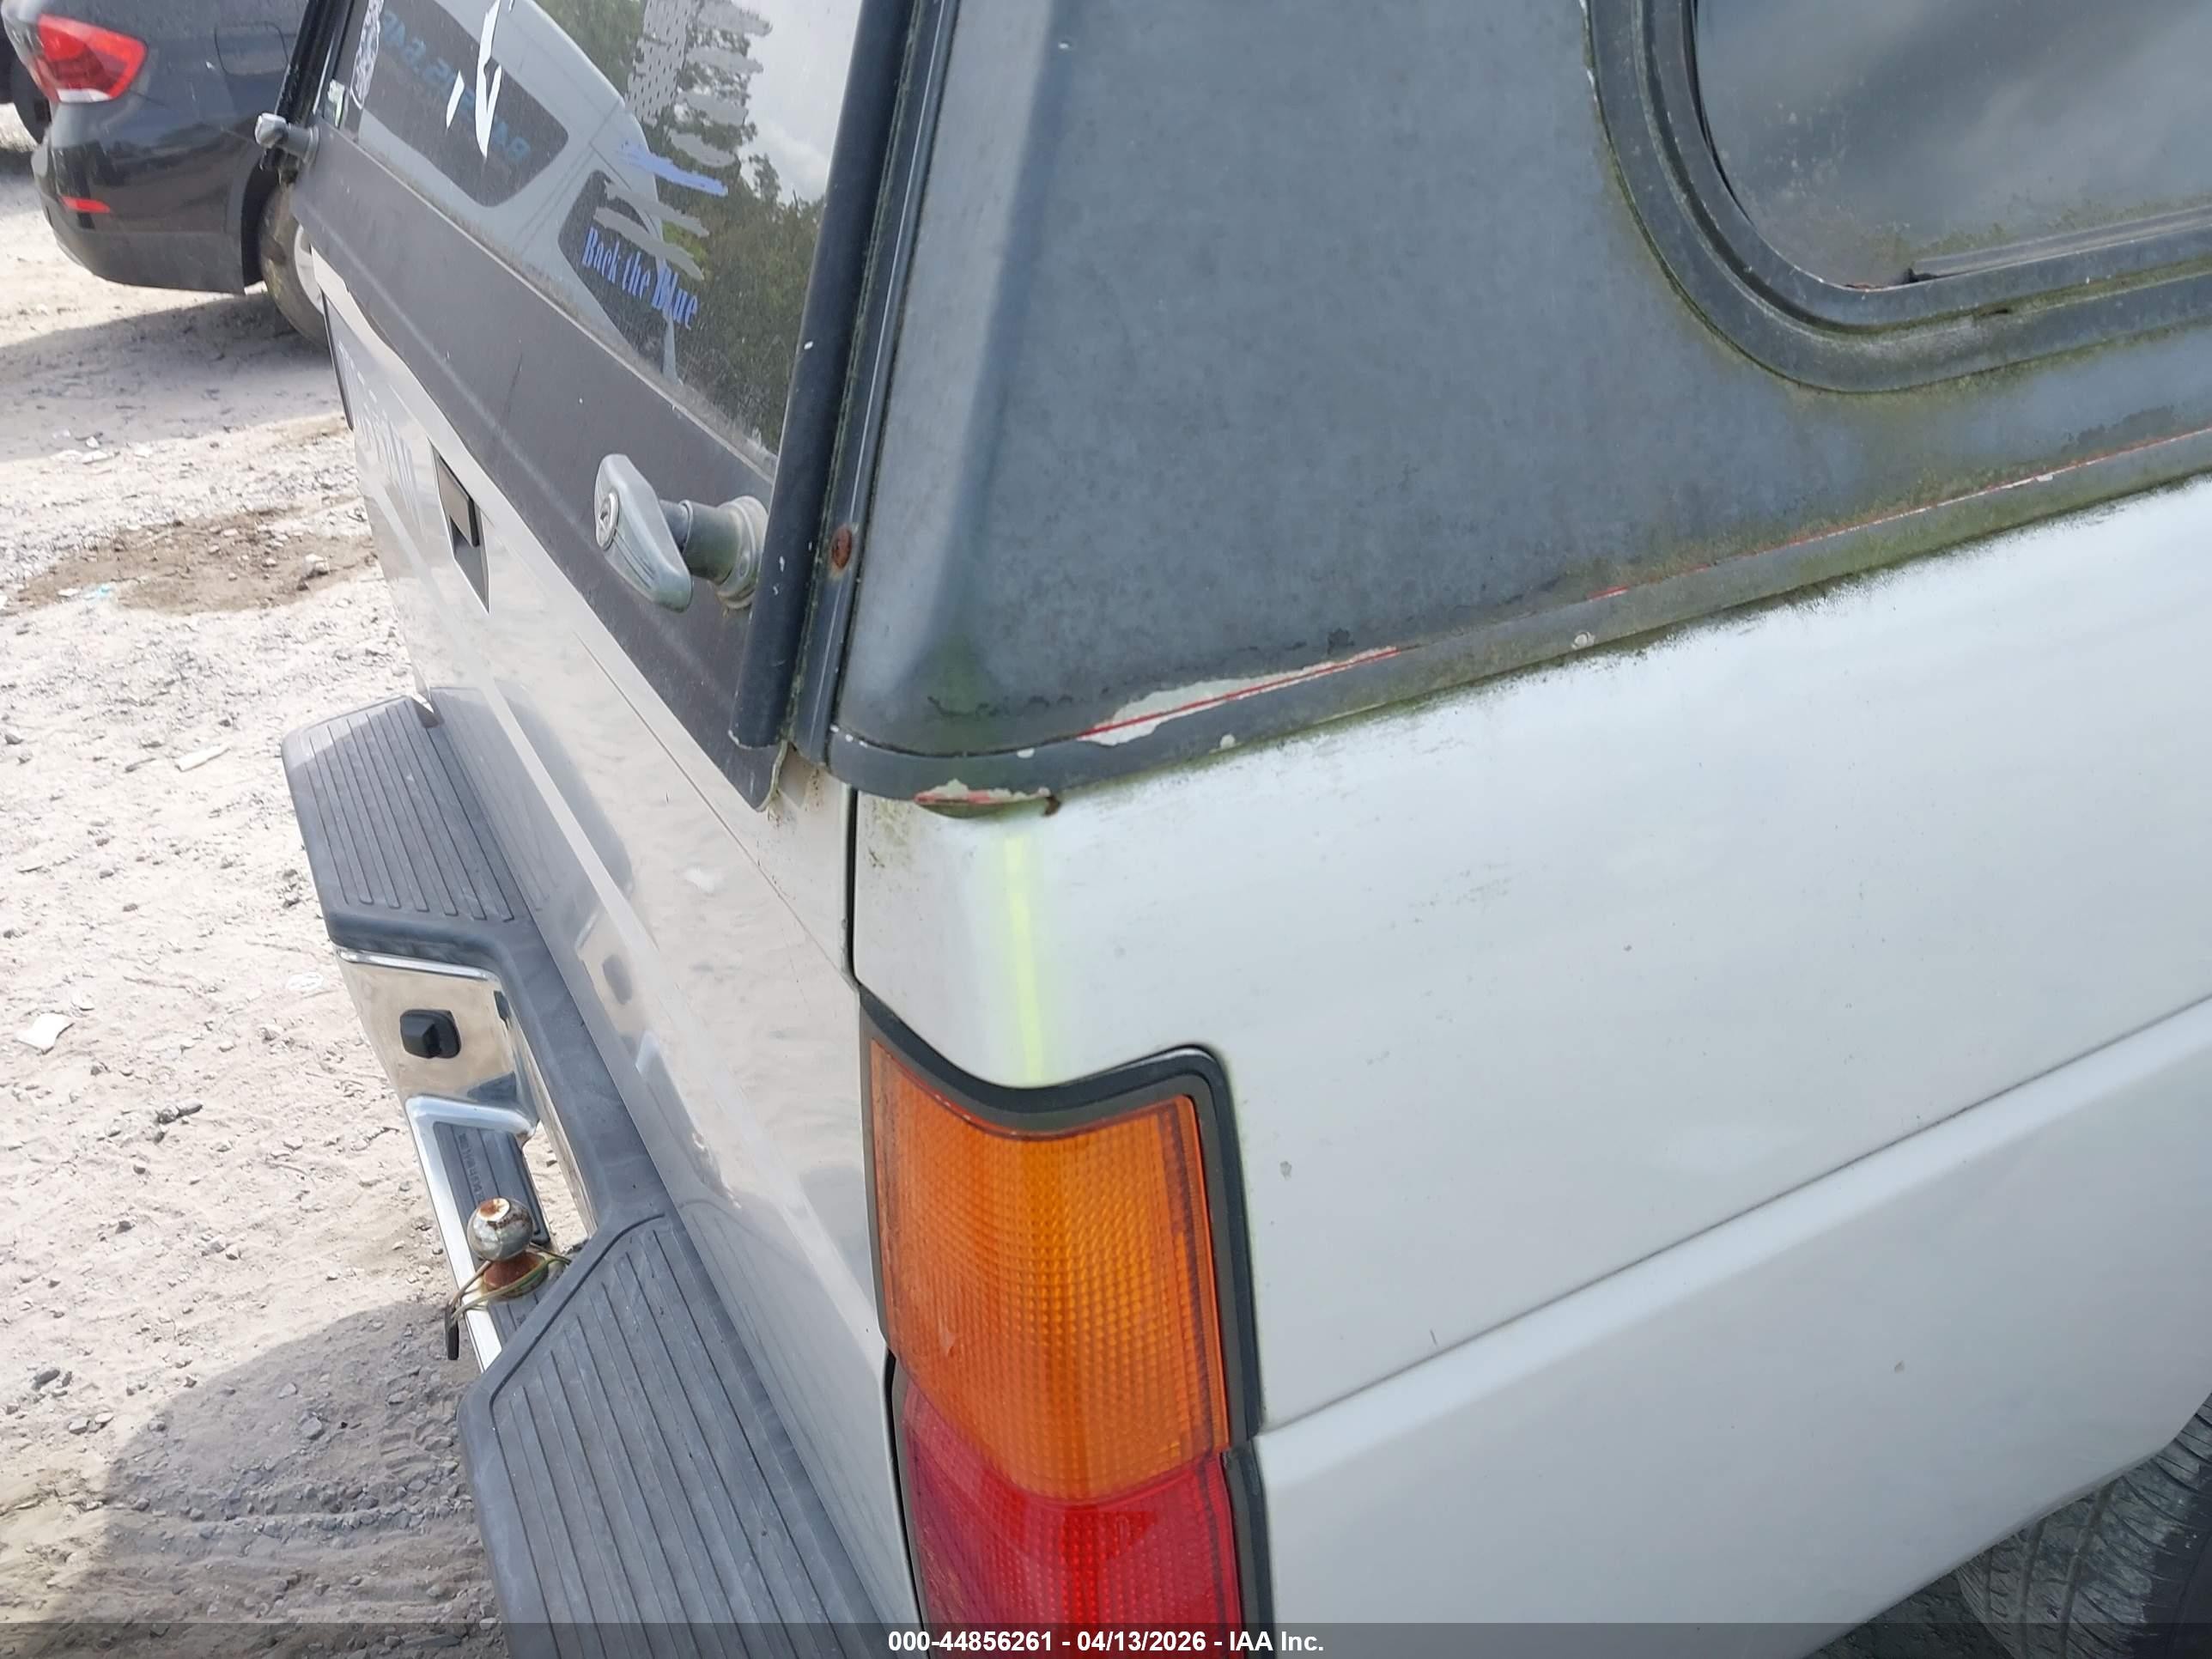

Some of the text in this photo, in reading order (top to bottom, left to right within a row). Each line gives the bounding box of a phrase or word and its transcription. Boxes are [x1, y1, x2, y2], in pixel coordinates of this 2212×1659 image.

[582, 227, 698, 331] Back the Blue
